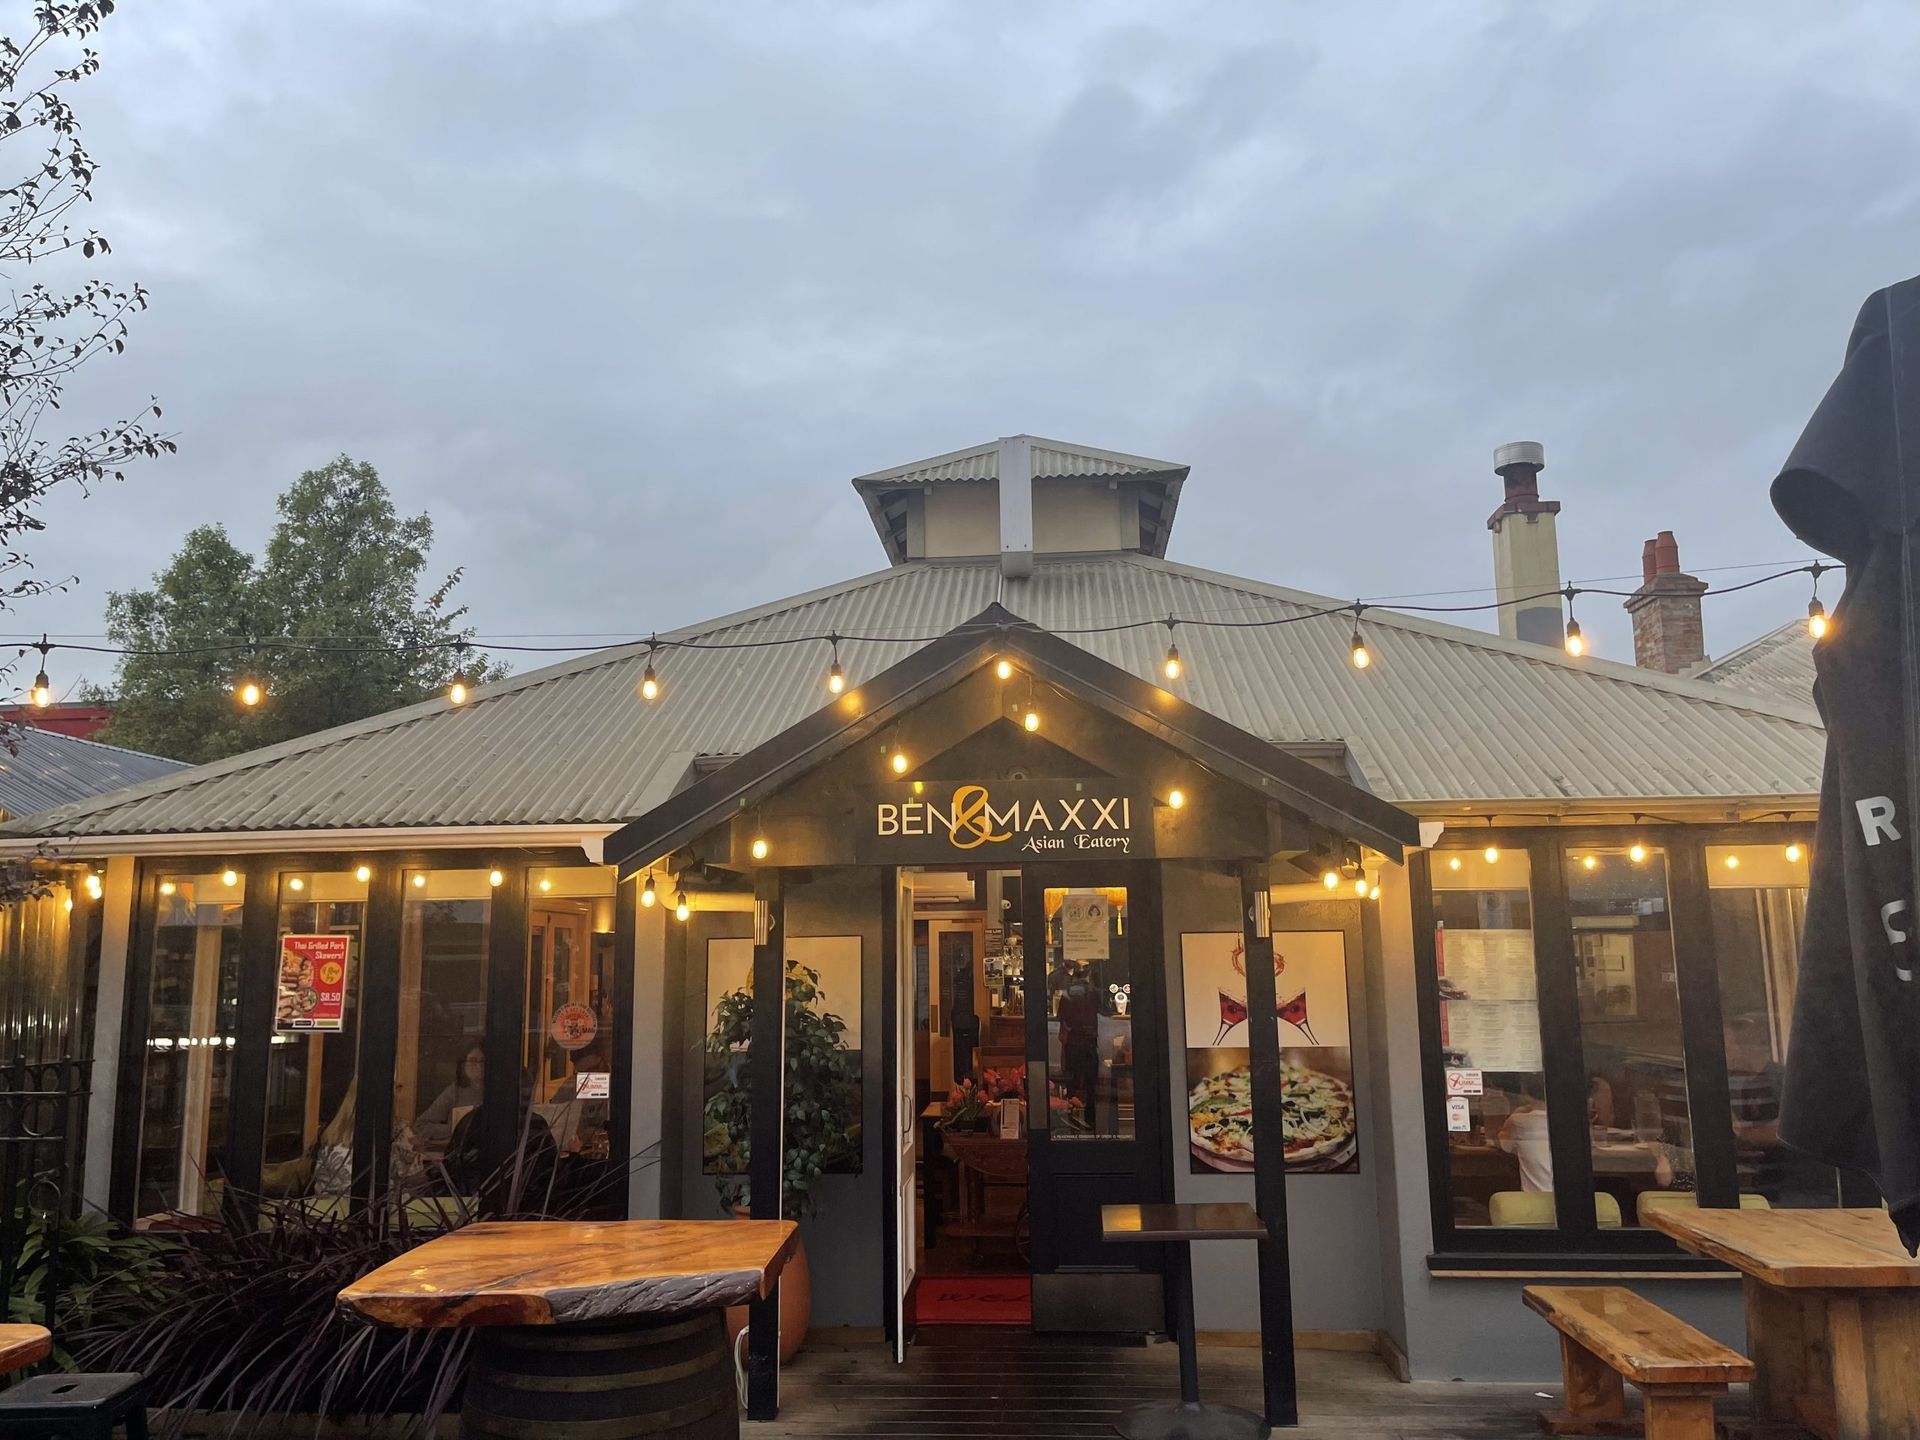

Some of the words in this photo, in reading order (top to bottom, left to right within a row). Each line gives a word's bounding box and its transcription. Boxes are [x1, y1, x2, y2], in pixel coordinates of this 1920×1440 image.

[878, 803, 957, 836] BEN
[949, 785, 1013, 849] &
[985, 797, 1130, 832] MAXXI
[1021, 836, 1065, 854] Asian
[1073, 834, 1130, 853] Eatery
[294, 941, 307, 950] Thai
[308, 941, 329, 950] Grilled
[329, 941, 345, 950] Pork
[320, 992, 341, 1002] $8.50
